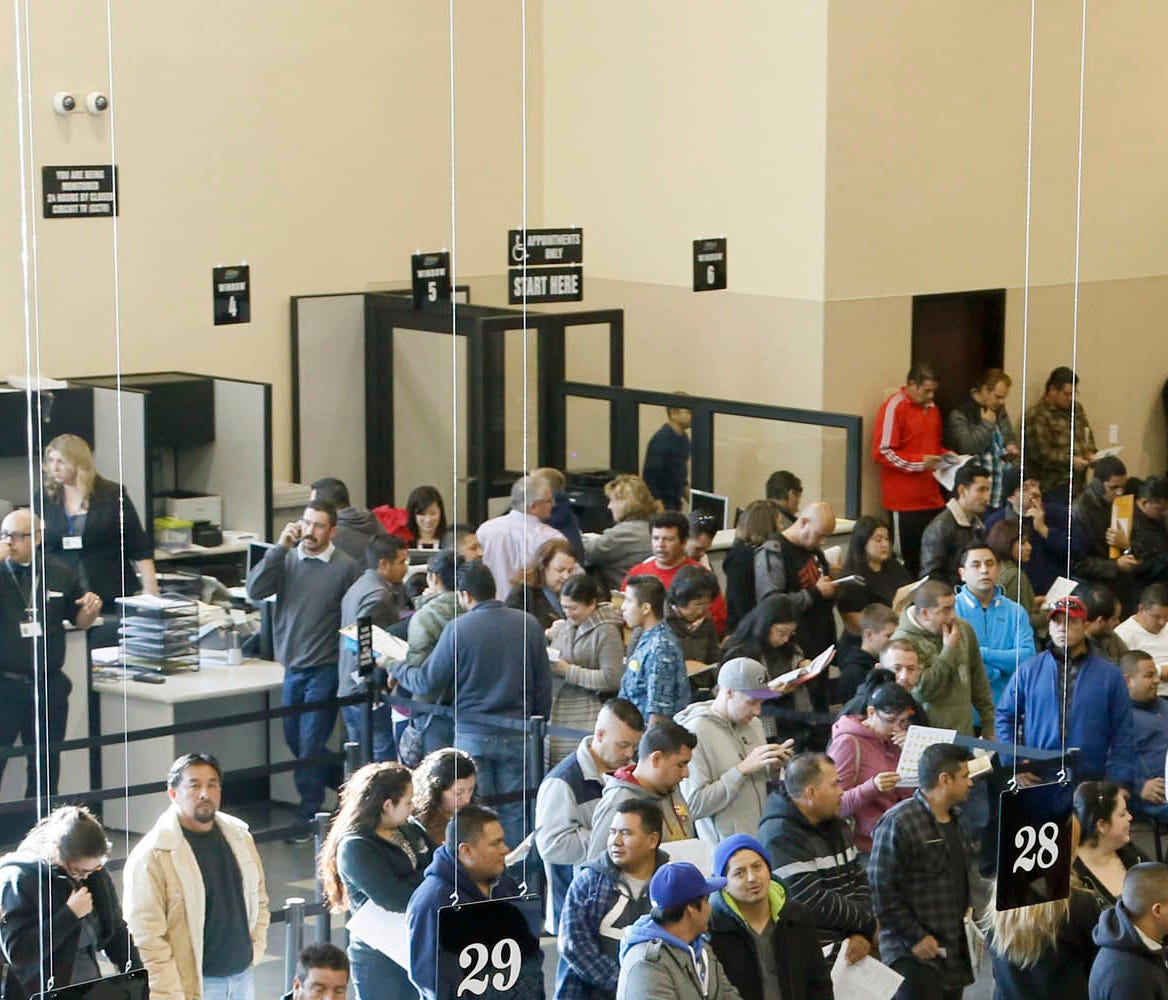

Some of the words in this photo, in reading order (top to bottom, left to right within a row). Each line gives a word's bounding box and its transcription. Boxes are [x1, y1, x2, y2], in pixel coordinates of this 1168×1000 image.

[527, 233, 580, 247] APPOINTMENTS
[545, 247, 563, 259] ONLY
[698, 252, 723, 262] WINDOW
[417, 268, 446, 278] WINDOW
[707, 265, 715, 285] 6
[218, 282, 246, 292] WINDOW
[428, 281, 437, 301] 5
[514, 275, 548, 296] START
[550, 274, 579, 295] HERE
[228, 295, 237, 317] 4
[1012, 821, 1059, 874] 28
[456, 938, 522, 998] 29
